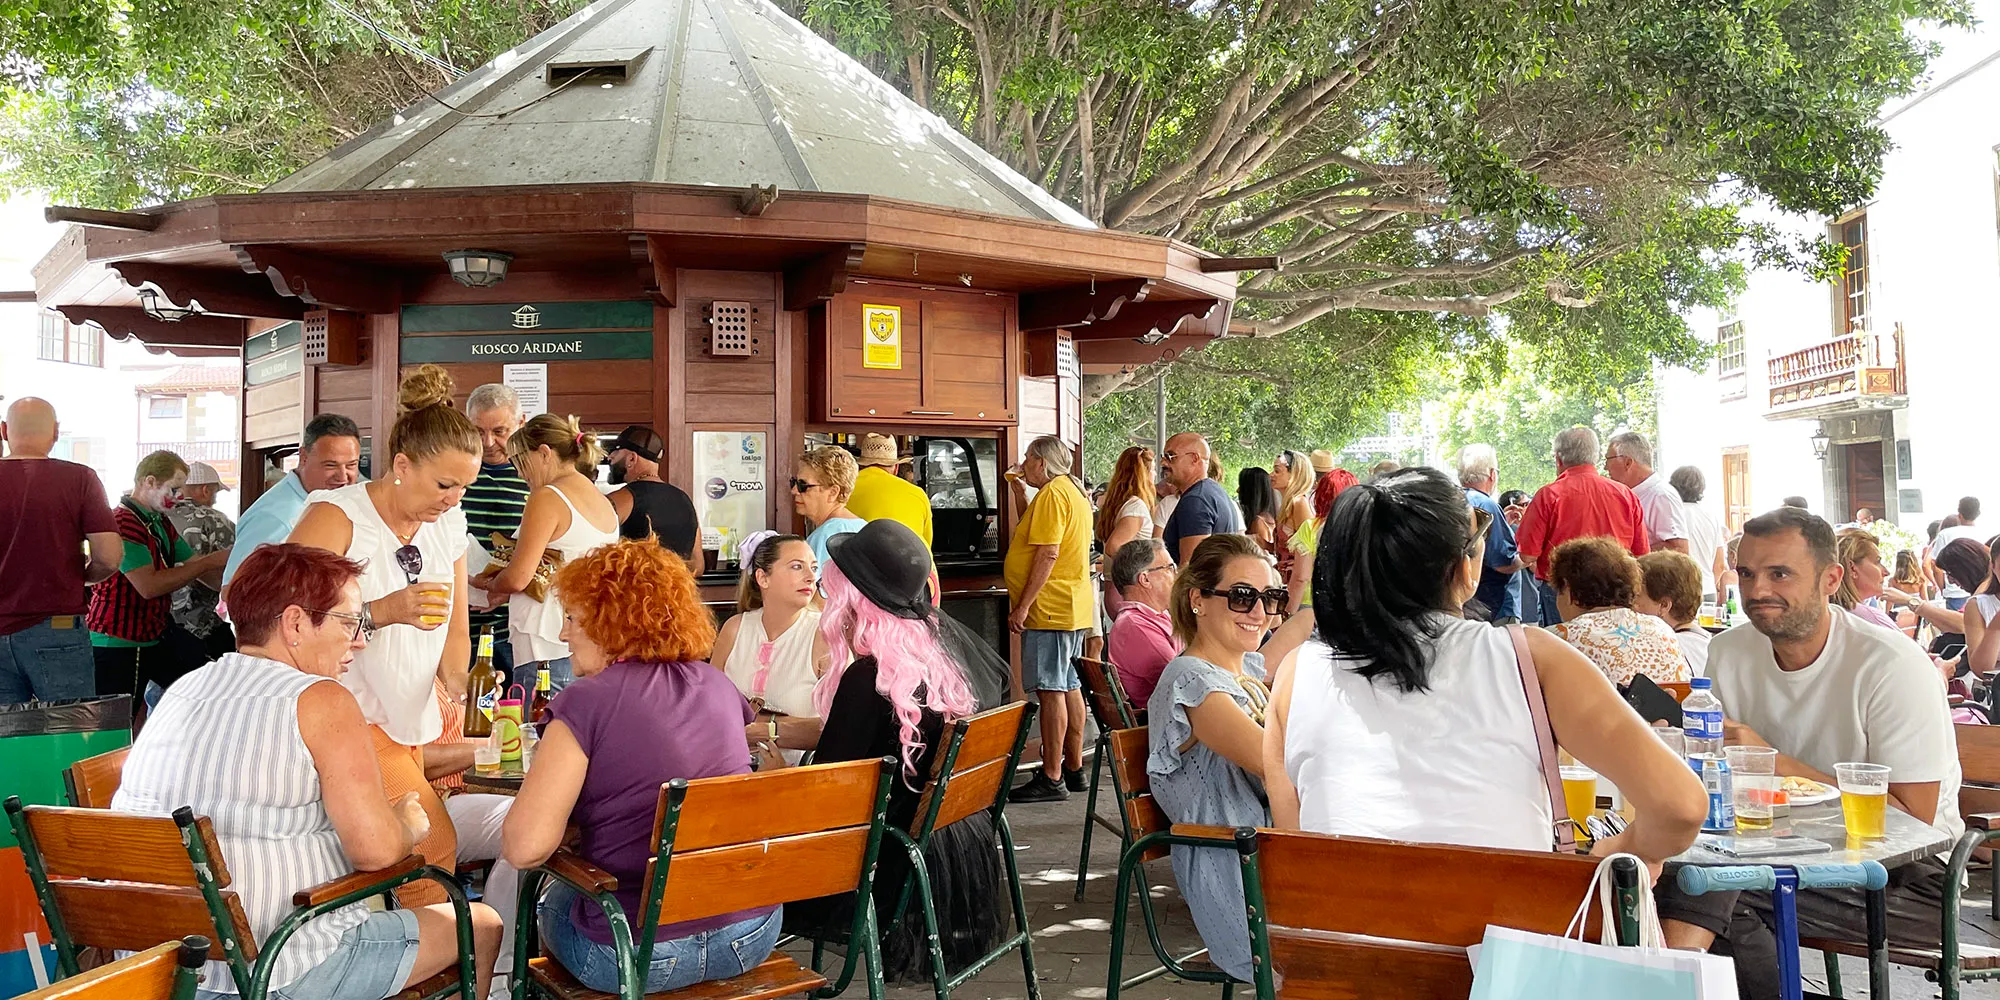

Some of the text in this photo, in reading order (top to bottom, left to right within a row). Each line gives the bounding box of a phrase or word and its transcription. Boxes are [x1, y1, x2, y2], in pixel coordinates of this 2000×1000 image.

[471, 341, 582, 354] KIOSCO ARIDANE
[1715, 870, 1761, 880] SCOOTER
